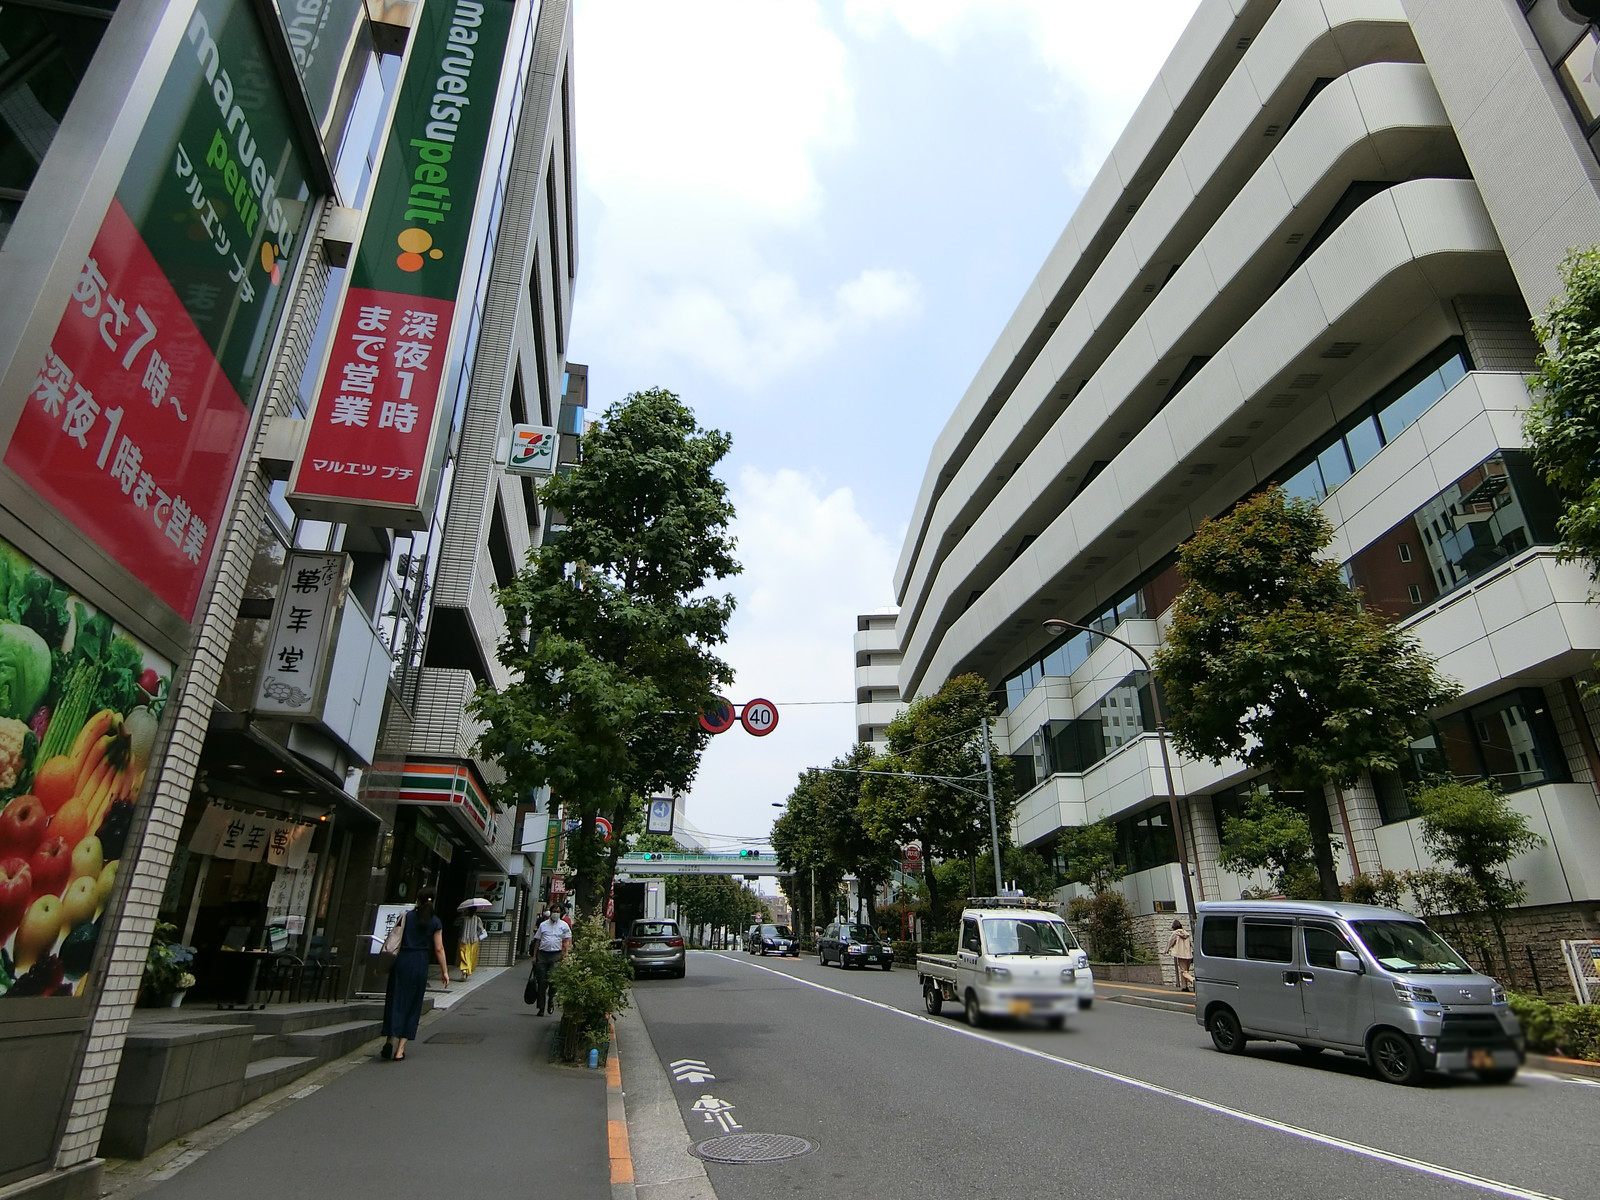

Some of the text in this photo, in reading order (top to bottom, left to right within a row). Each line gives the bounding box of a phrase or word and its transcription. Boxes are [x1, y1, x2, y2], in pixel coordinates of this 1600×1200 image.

[188, 10, 293, 259] maruetsu
[206, 128, 259, 239] petit
[176, 142, 231, 256] マルエツ
[330, 305, 392, 428] まで営業
[378, 309, 439, 434] 深夜1時
[28, 346, 208, 566] 深夜1時まで営業
[312, 459, 414, 480] マルエツ プチ
[277, 569, 322, 673] 萬年堂
[749, 708, 771, 725] 40
